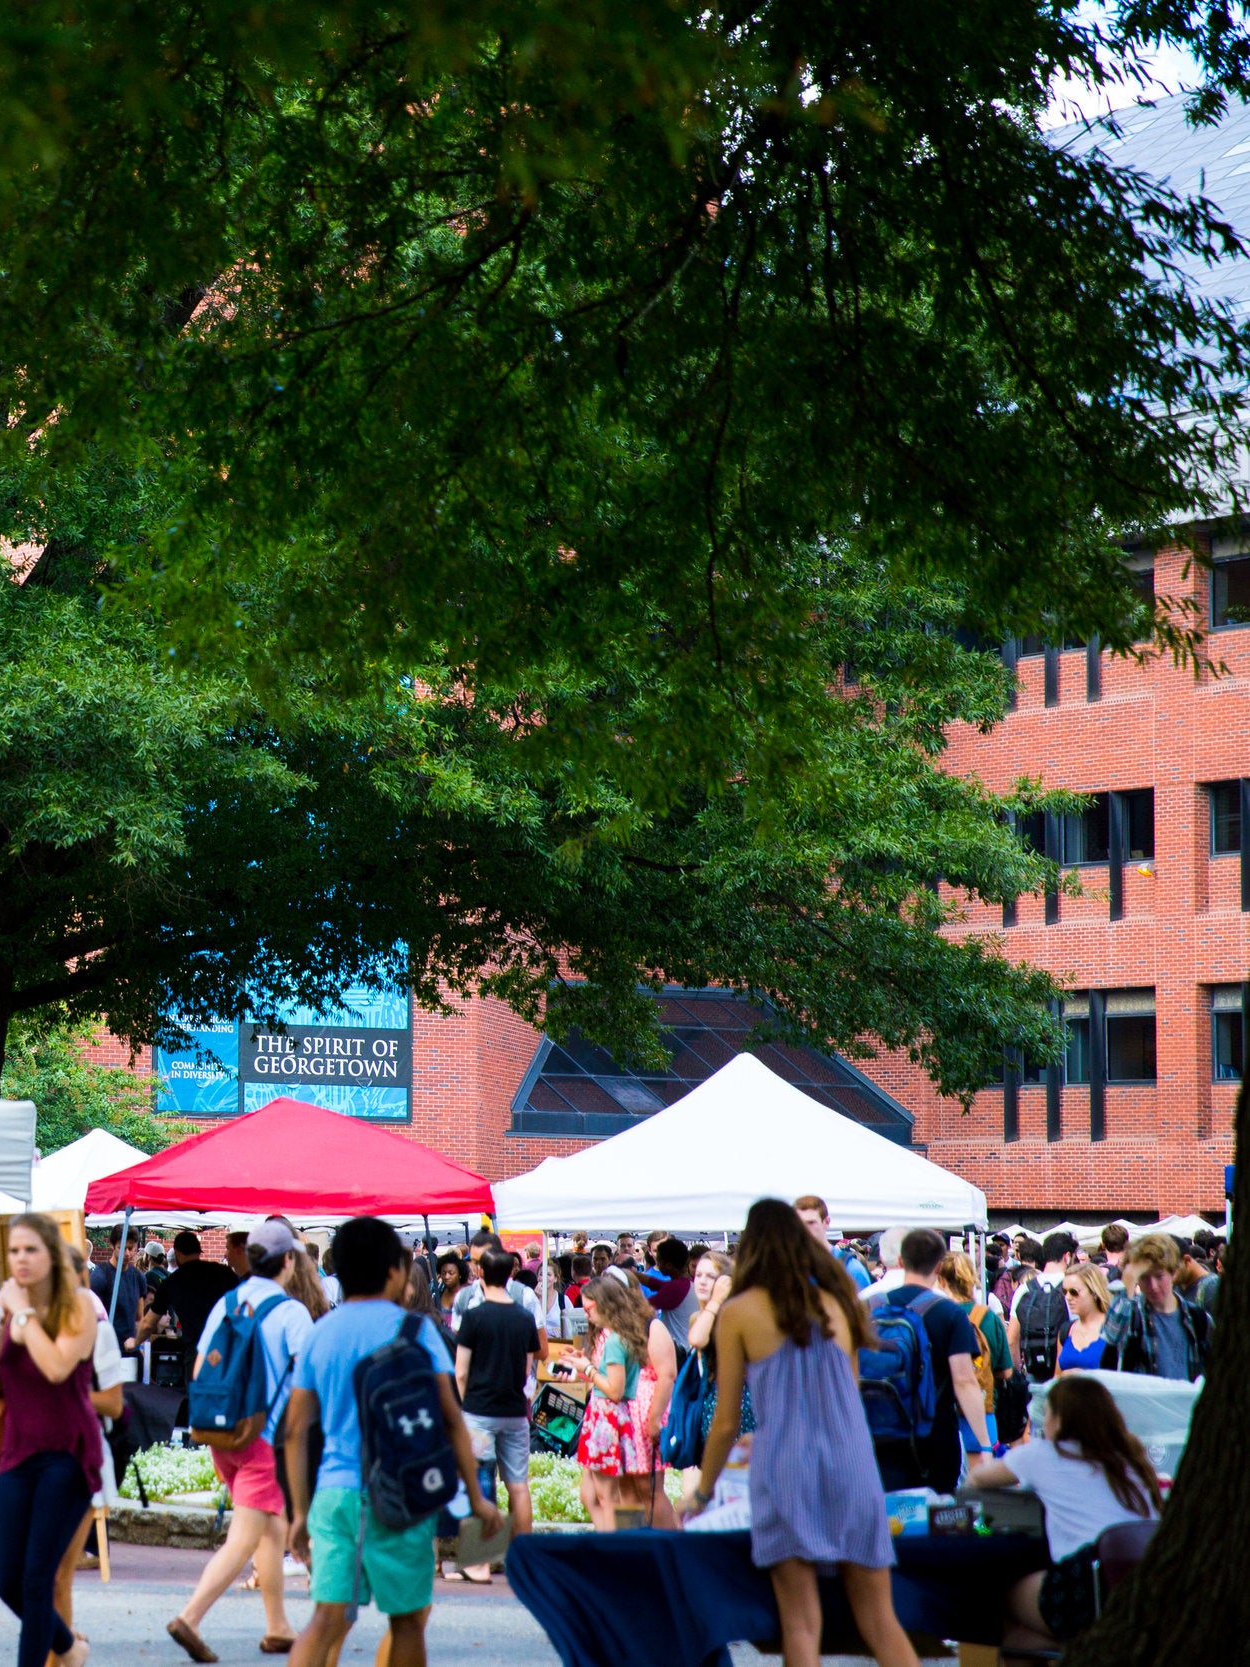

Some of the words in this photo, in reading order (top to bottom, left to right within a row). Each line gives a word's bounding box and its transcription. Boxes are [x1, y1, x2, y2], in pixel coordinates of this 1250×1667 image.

[163, 1021, 234, 1033] DERSTANDING
[256, 1035, 295, 1053] THE
[303, 1037, 365, 1056] SPIRIT
[372, 1039, 399, 1057] OF
[254, 1055, 398, 1078] GEORGETOWN
[171, 1071, 181, 1079] IN
[183, 1071, 225, 1080] DIVERSITY
